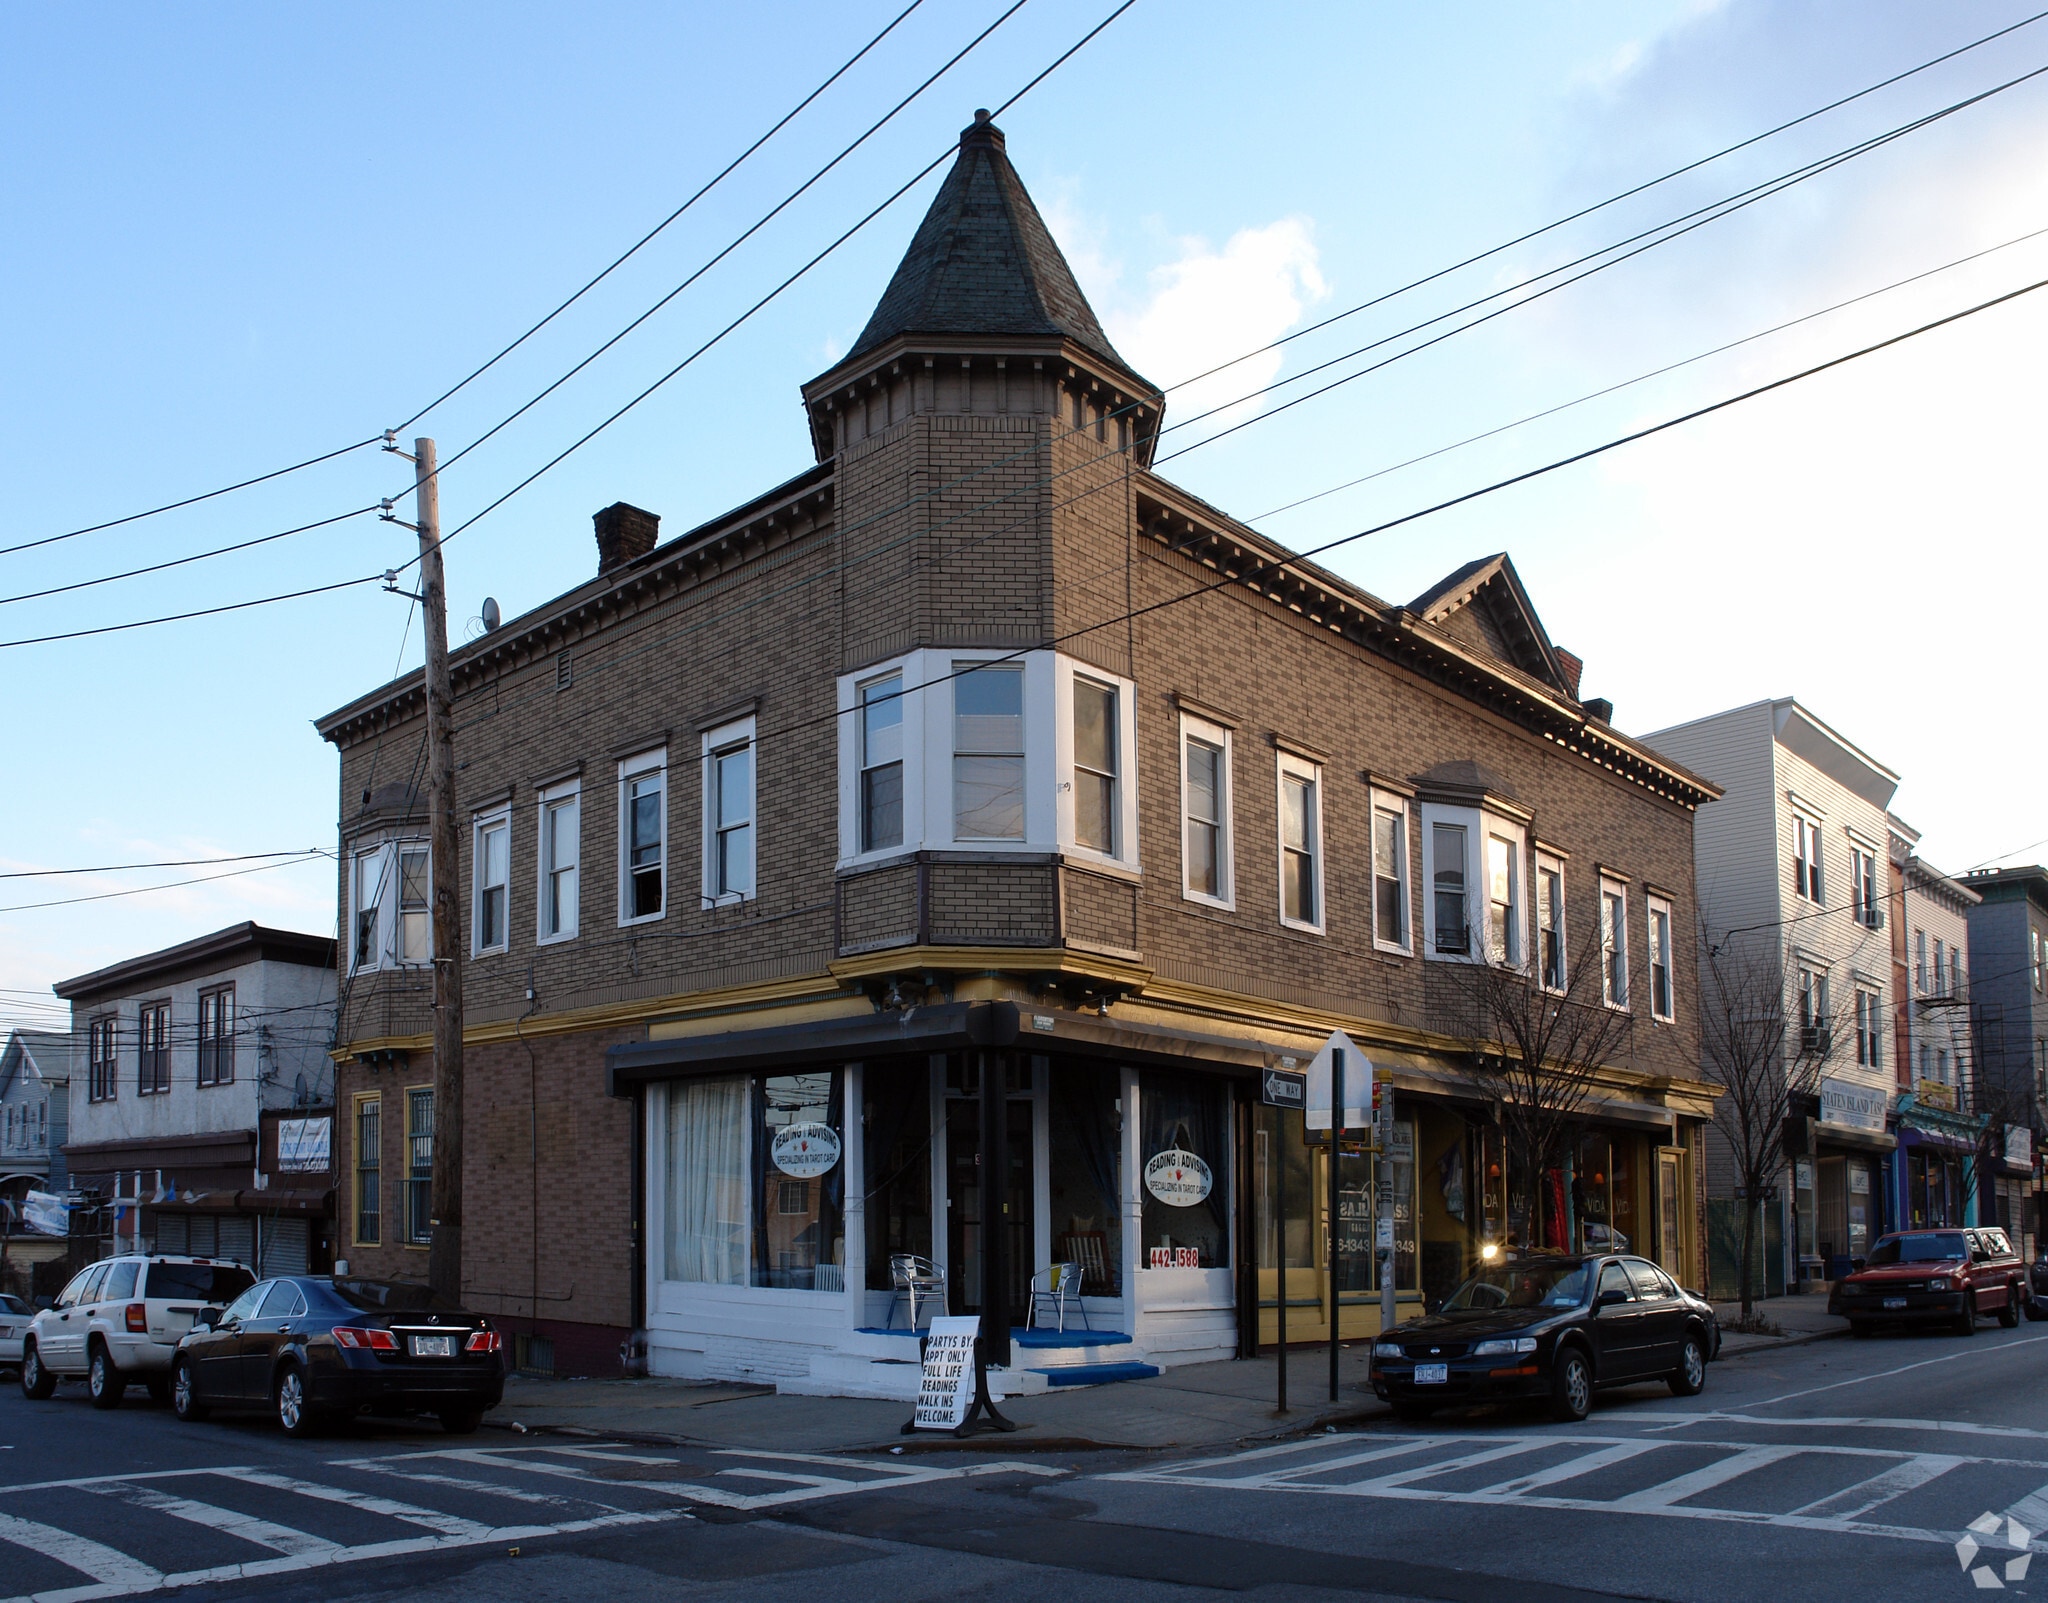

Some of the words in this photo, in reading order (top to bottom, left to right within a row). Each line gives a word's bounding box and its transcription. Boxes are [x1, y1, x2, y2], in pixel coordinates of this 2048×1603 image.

[1270, 1080, 1281, 1095] ONE
[1285, 1083, 1299, 1097] WAY
[1822, 1090, 1846, 1109] STATEN
[1846, 1095, 1869, 1113] ISLAND
[776, 1125, 802, 1152] READING
[807, 1125, 837, 1150] ADVISING
[777, 1154, 804, 1165] SPECIALIZING
[809, 1154, 823, 1164] TAROT
[823, 1153, 836, 1163] CARD
[1149, 1153, 1176, 1177] READING
[1181, 1153, 1209, 1181] ADVISING
[1150, 1180, 1177, 1193] SPECIALIZING
[1182, 1184, 1196, 1195] TAROT
[1196, 1185, 1207, 1196] CARD
[929, 1335, 957, 1348] PARTYS
[961, 1336, 973, 1348] BY.
[925, 1350, 944, 1362] APPT
[947, 1350, 967, 1362] ONLY
[923, 1365, 941, 1378] FULL
[945, 1365, 962, 1378] LIFE
[922, 1380, 958, 1393] READINGS
[918, 1395, 939, 1407] WALK
[941, 1395, 954, 1408] INS
[916, 1410, 956, 1423] WELCOME.
